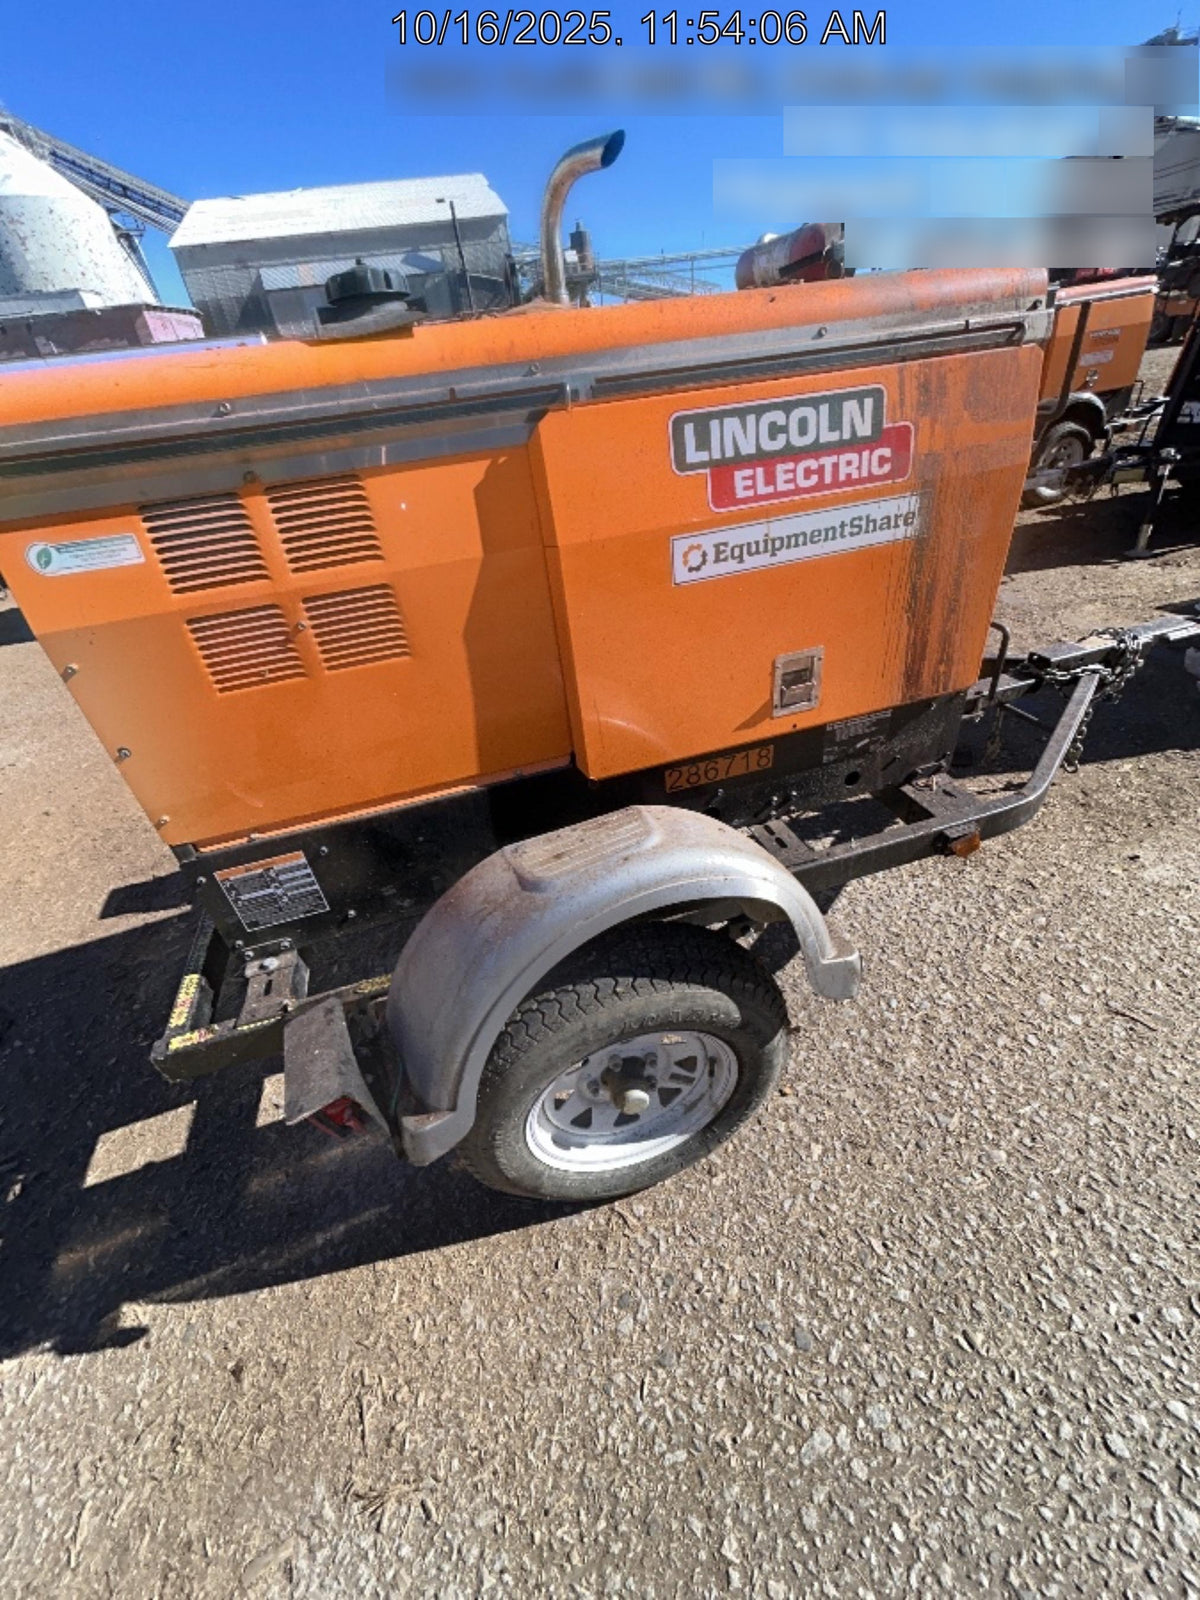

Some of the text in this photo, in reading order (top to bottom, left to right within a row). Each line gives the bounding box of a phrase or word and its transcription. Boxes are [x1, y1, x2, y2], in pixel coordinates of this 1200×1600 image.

[684, 398, 874, 463] LINCOLN
[734, 447, 892, 499] ELECTRIC
[712, 510, 916, 564] EquipmentShare
[667, 747, 771, 791] 286718
